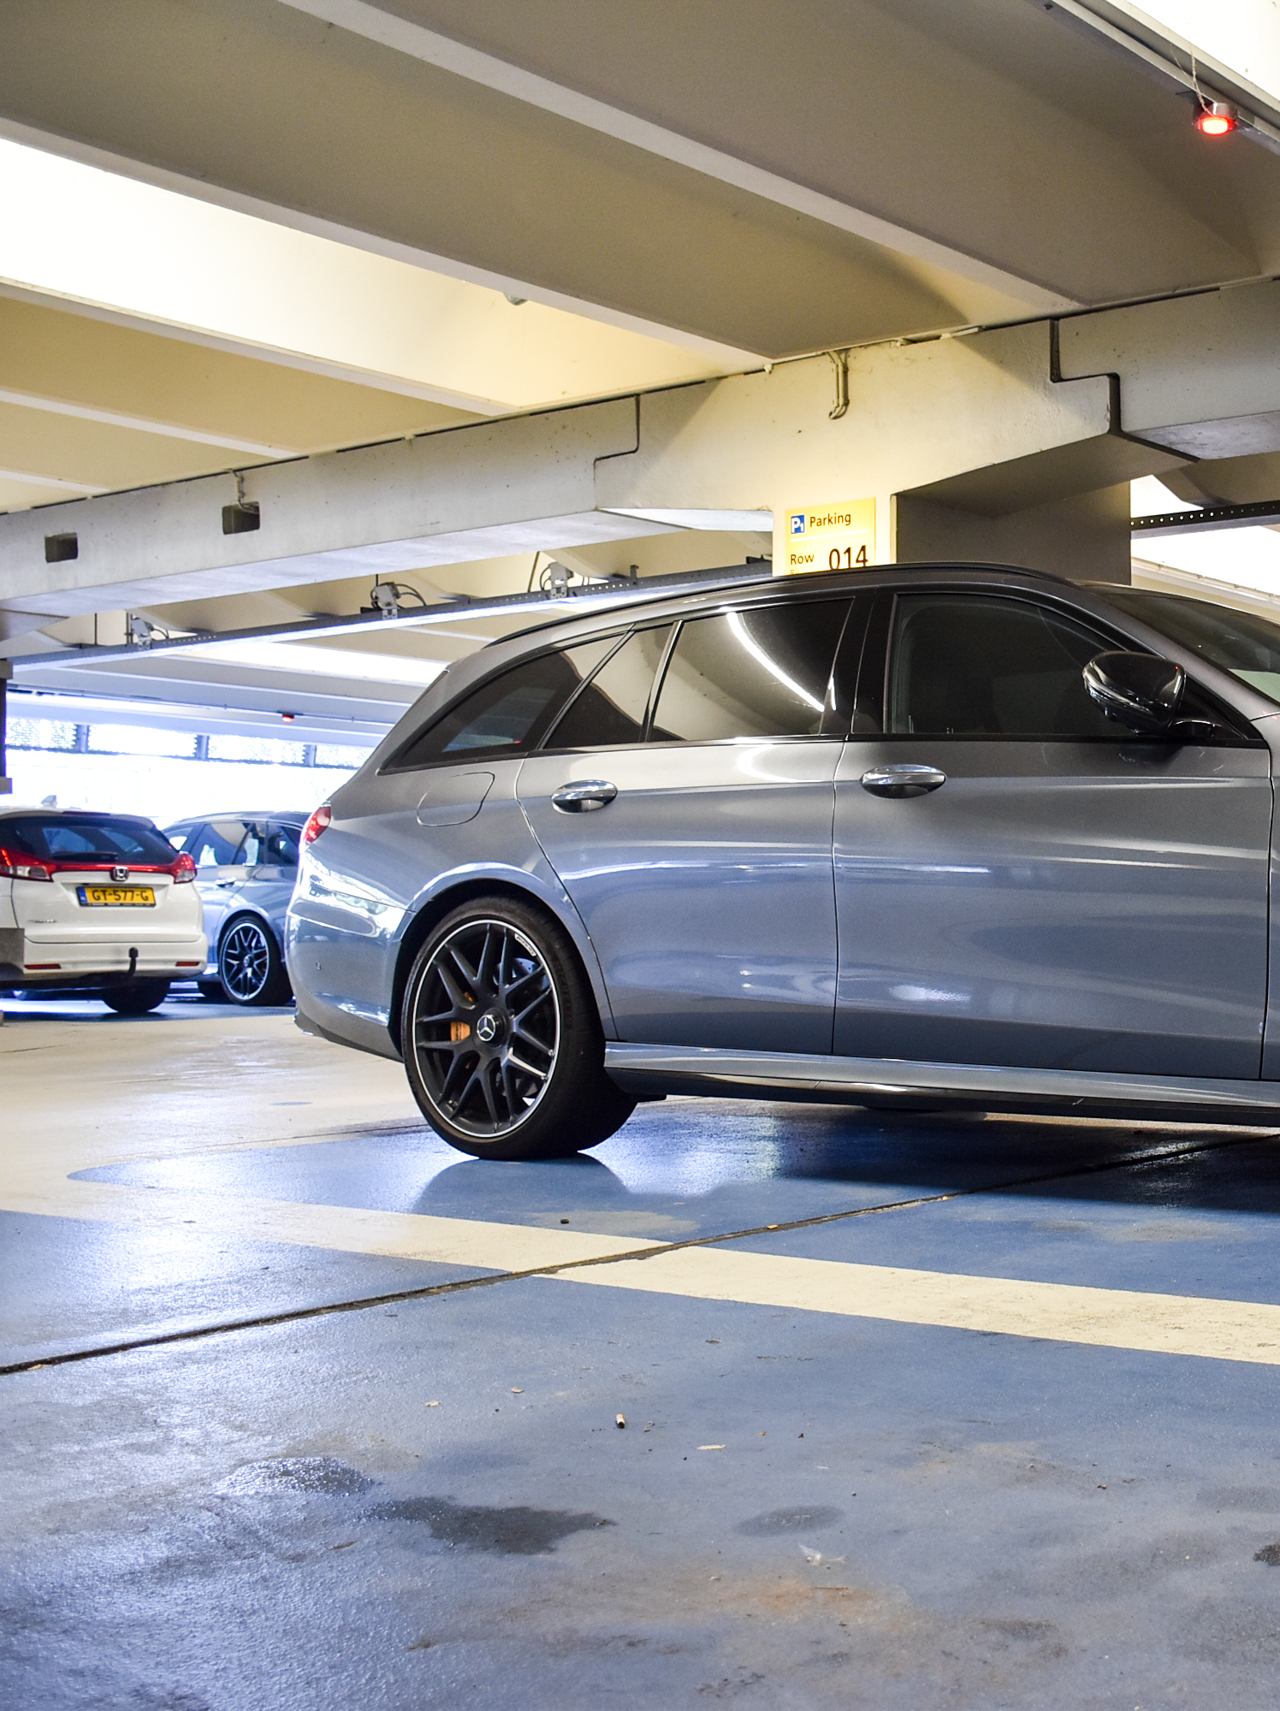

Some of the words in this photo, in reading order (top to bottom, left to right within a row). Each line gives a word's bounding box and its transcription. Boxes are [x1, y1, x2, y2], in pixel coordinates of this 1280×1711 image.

[809, 512, 851, 527] Parking
[790, 553, 815, 565] Row
[828, 545, 869, 570] 014
[92, 889, 149, 901] GT-577-G
